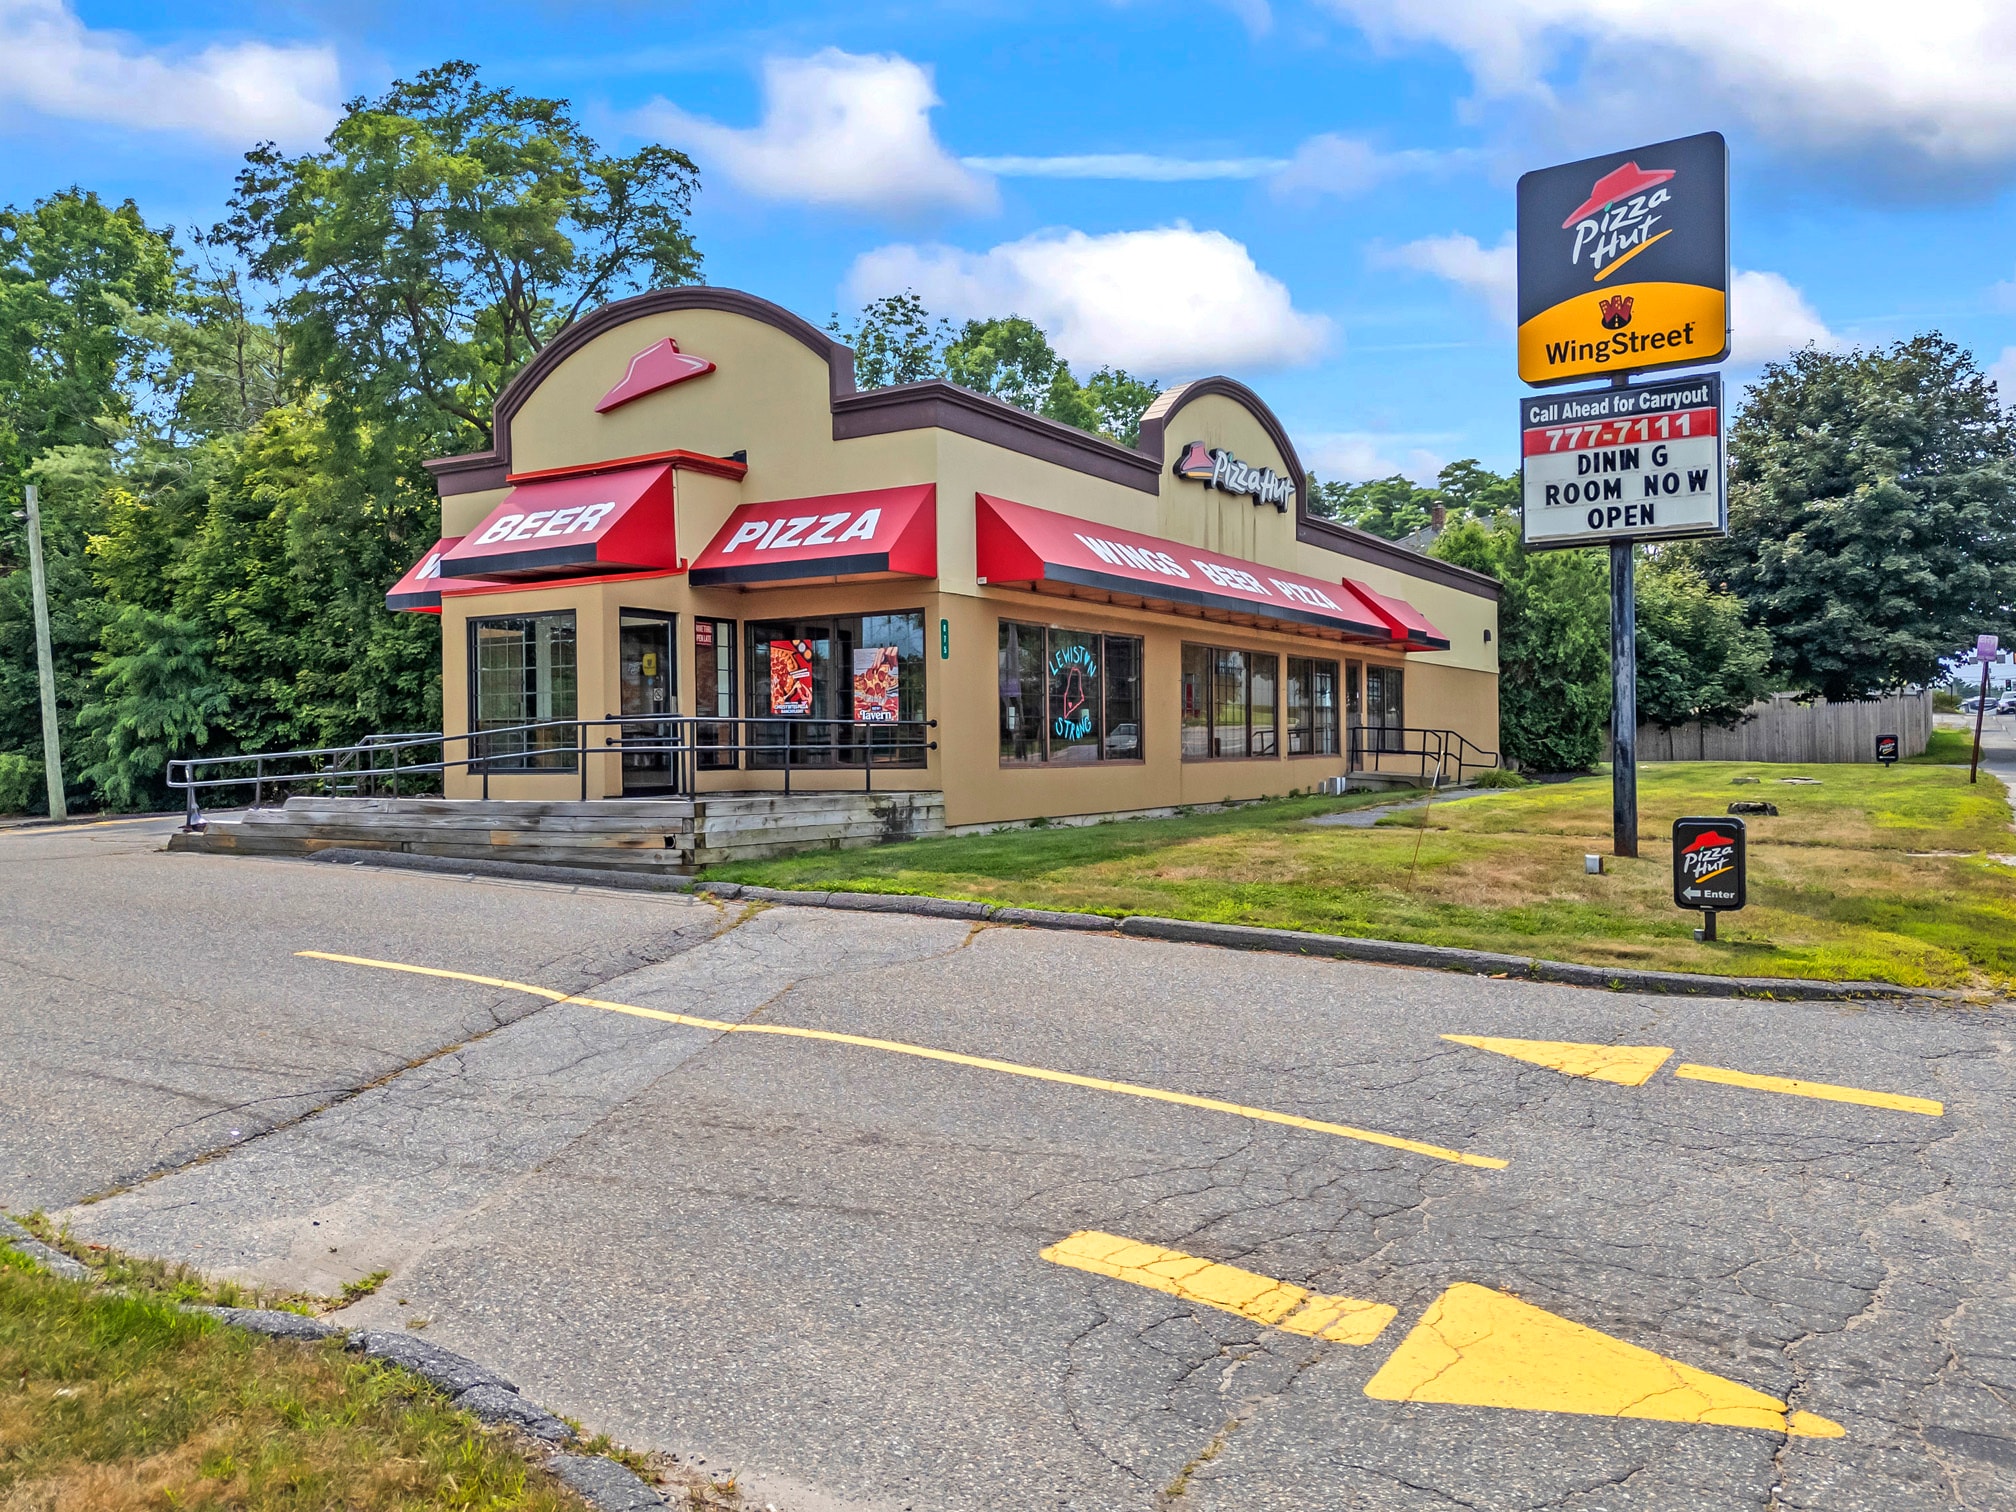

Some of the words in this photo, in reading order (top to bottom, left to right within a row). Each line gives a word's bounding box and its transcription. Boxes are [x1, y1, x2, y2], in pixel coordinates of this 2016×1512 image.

[1572, 188, 1671, 265] Pizza
[1590, 215, 1662, 269] Hut
[1545, 322, 1694, 365] WingStreet
[1530, 405, 1558, 424] Call
[1562, 397, 1609, 419] Ahead
[1613, 395, 1635, 413] for
[1639, 385, 1709, 410] Carryout
[1546, 413, 1691, 452] 777-7111
[1213, 450, 1261, 492] Pizza
[1260, 469, 1296, 511] Hut
[1545, 477, 1622, 506] ROOM
[1644, 469, 1709, 497] NOW
[473, 501, 617, 546] BEER
[721, 507, 883, 554] PIZZA
[1587, 503, 1655, 530] OPEN
[1074, 533, 1190, 579] WINGS
[1191, 559, 1273, 596] BEER
[1268, 577, 1343, 612] PIZZA
[859, 709, 892, 720] Tavern
[1055, 715, 1092, 742] STRONG
[1683, 845, 1734, 873] Pizza
[1693, 857, 1730, 878] Hut
[1704, 889, 1735, 899] Enter
